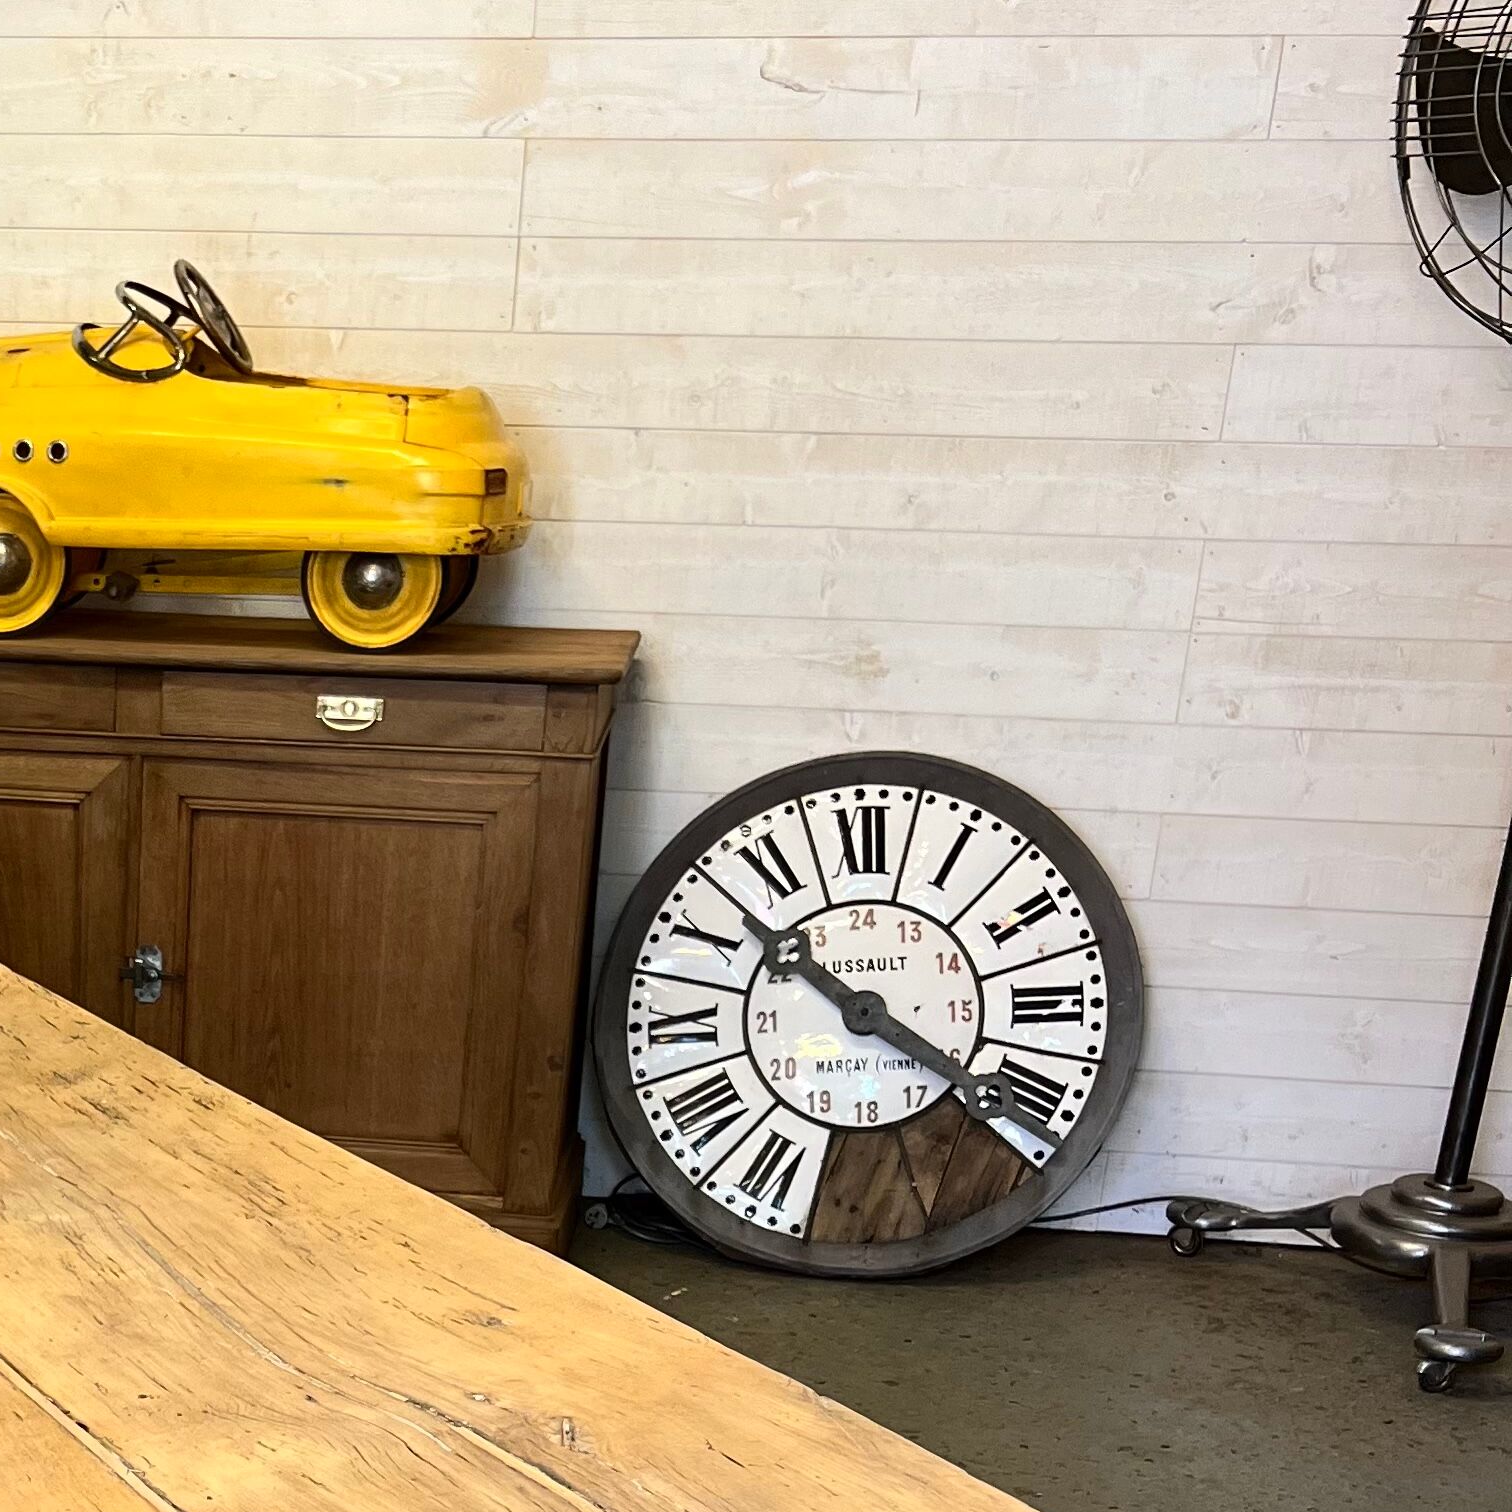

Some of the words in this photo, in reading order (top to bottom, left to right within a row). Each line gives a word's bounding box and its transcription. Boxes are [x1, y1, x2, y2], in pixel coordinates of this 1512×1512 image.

[831, 806, 890, 879] XII
[733, 829, 807, 910] XI
[848, 908, 877, 931] 24
[669, 908, 744, 967] X
[803, 925, 827, 948] 3
[896, 920, 922, 944] 13
[935, 952, 961, 975] 14
[756, 1010, 778, 1034] 21
[947, 999, 973, 1024] 15
[770, 1057, 797, 1081] 20
[815, 1057, 869, 1077] MARÇAY
[806, 1090, 832, 1114] 19
[903, 1085, 928, 1109] 17
[854, 1101, 879, 1124] 18
